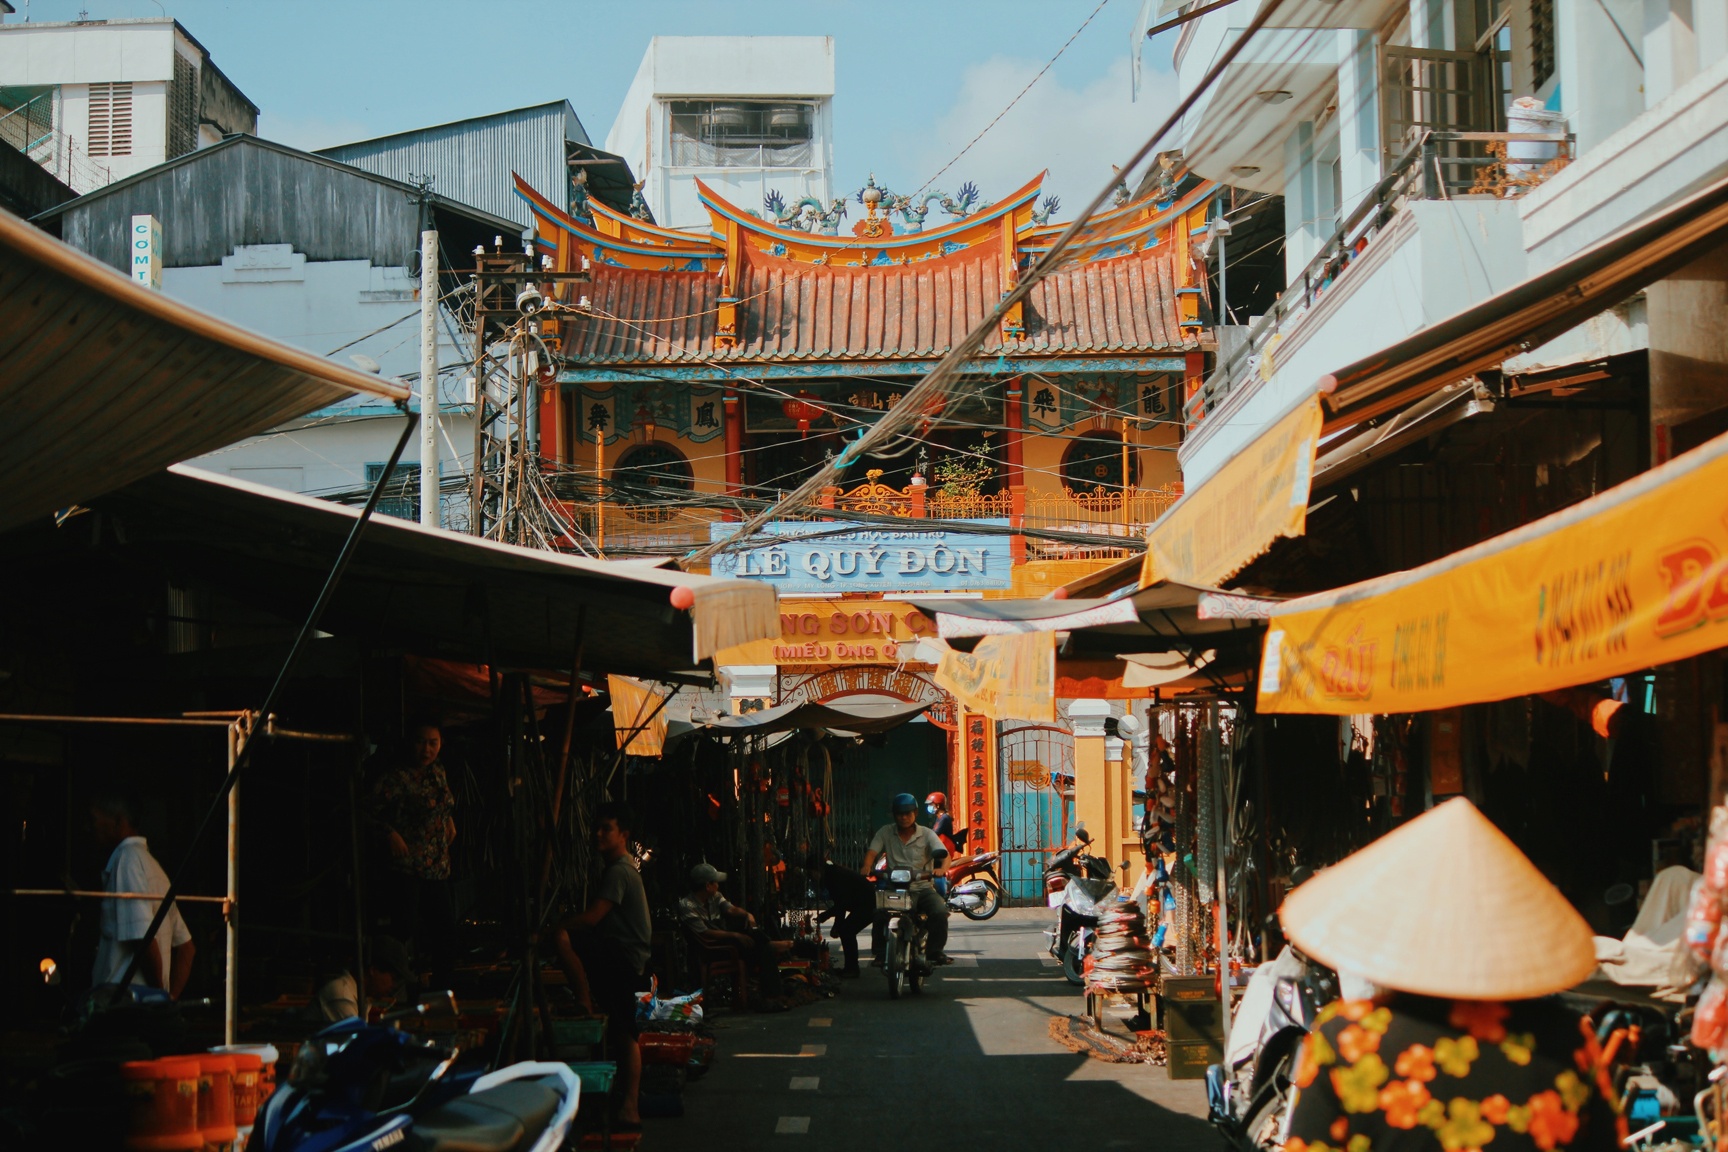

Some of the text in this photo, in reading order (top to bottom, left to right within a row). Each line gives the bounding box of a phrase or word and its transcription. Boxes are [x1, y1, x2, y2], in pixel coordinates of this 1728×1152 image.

[1141, 385, 1166, 414] 龍
[735, 543, 989, 580] LÊ QUÝ ĐÔN
[780, 612, 821, 635] NG
[830, 608, 894, 635] SƠN
[834, 642, 876, 658] ÔNG
[882, 645, 898, 659] Q
[371, 1127, 405, 1152] YAMAHA
